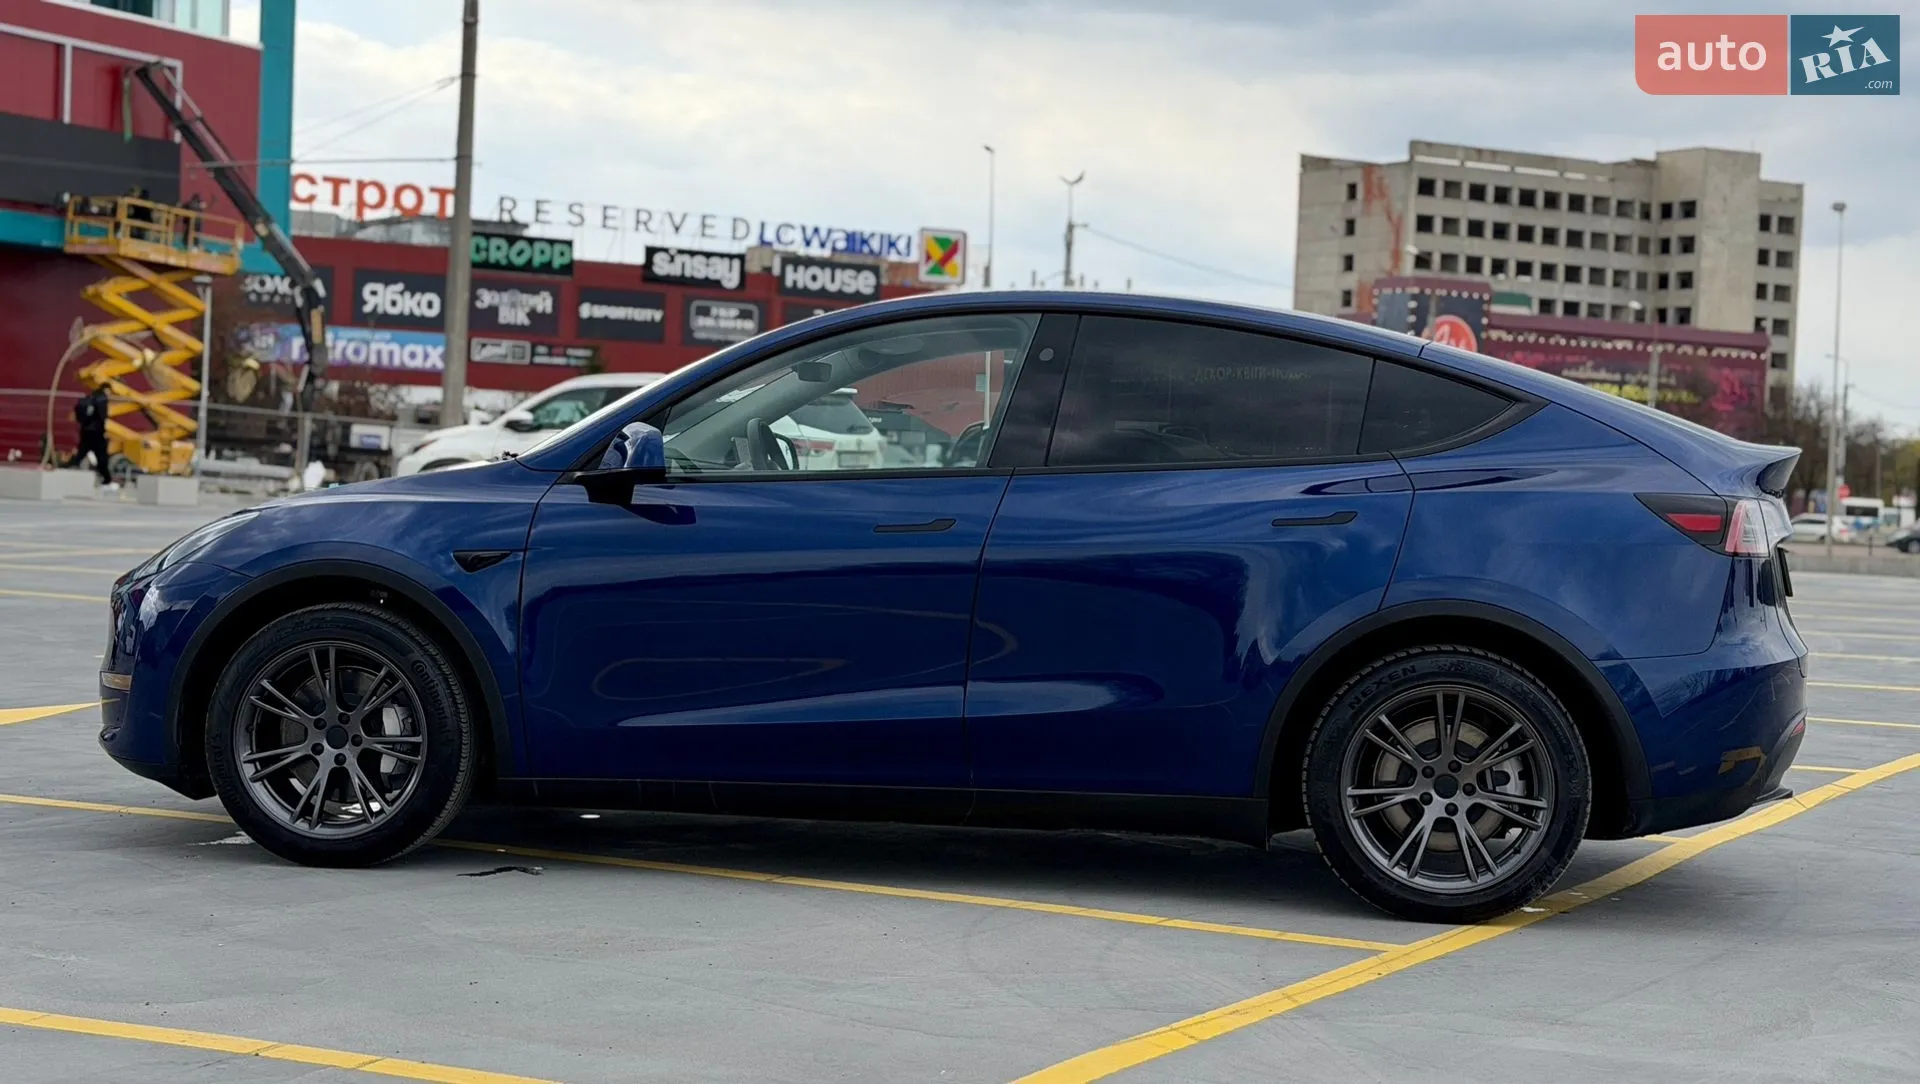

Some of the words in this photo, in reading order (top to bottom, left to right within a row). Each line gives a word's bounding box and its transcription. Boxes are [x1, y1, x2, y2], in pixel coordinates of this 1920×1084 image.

[499, 196, 750, 240] RESERVED
[470, 234, 572, 269] CROPP
[651, 246, 741, 290] sinsay
[361, 281, 442, 318] Ябко
[1347, 664, 1417, 710] NEXEN
